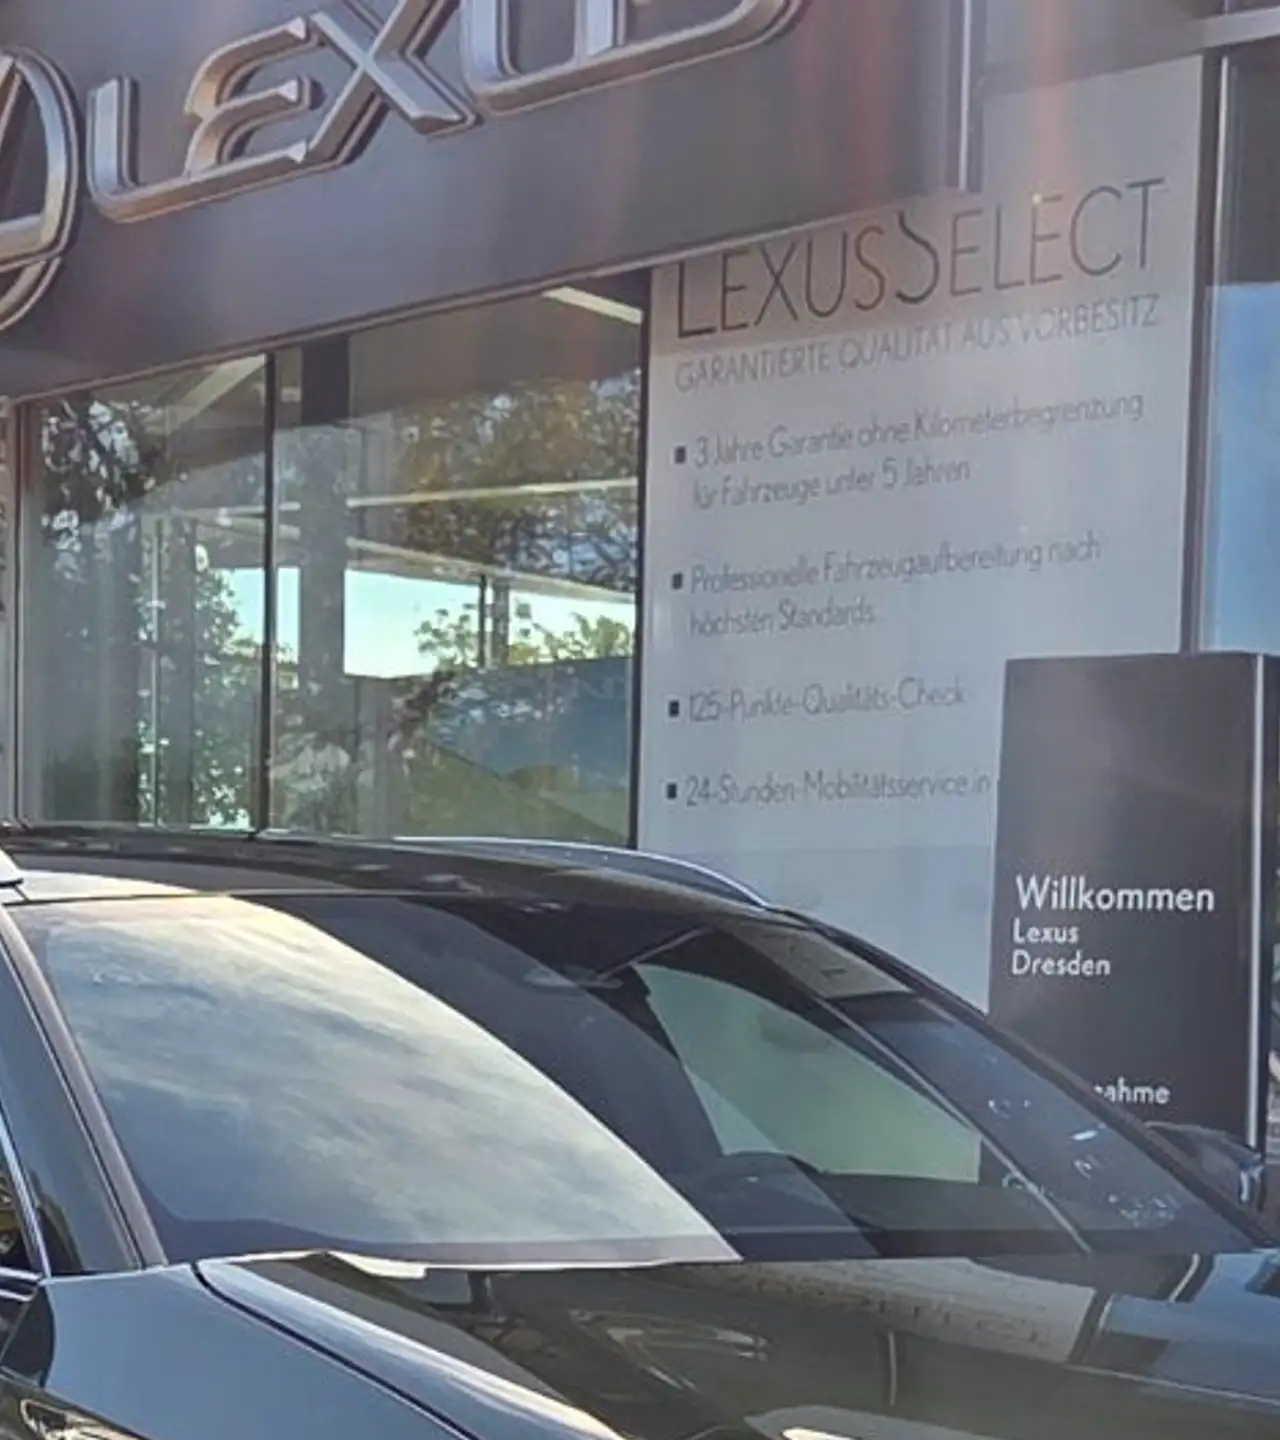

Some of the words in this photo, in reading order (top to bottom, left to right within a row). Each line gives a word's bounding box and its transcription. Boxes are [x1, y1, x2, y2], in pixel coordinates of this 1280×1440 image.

[675, 341, 830, 393] GARANTIERTE
[963, 314, 1010, 350] AUS
[1013, 293, 1160, 344] VORBESITZ
[694, 435, 710, 469] 3
[714, 434, 764, 466] Jahre
[769, 423, 854, 458] Garantie
[858, 414, 910, 448] ohne
[914, 394, 1143, 442] Kilometerbegrenzung
[721, 474, 820, 506] Fahrzeuge
[825, 467, 875, 496] unter
[882, 456, 898, 490] 5
[902, 454, 971, 487] Jahren
[689, 554, 818, 594] Professionelle
[1047, 529, 1102, 562] nach
[1015, 874, 1215, 912] Willkommen
[1013, 917, 1079, 944] Lexus
[1012, 949, 1111, 976] Dresden
